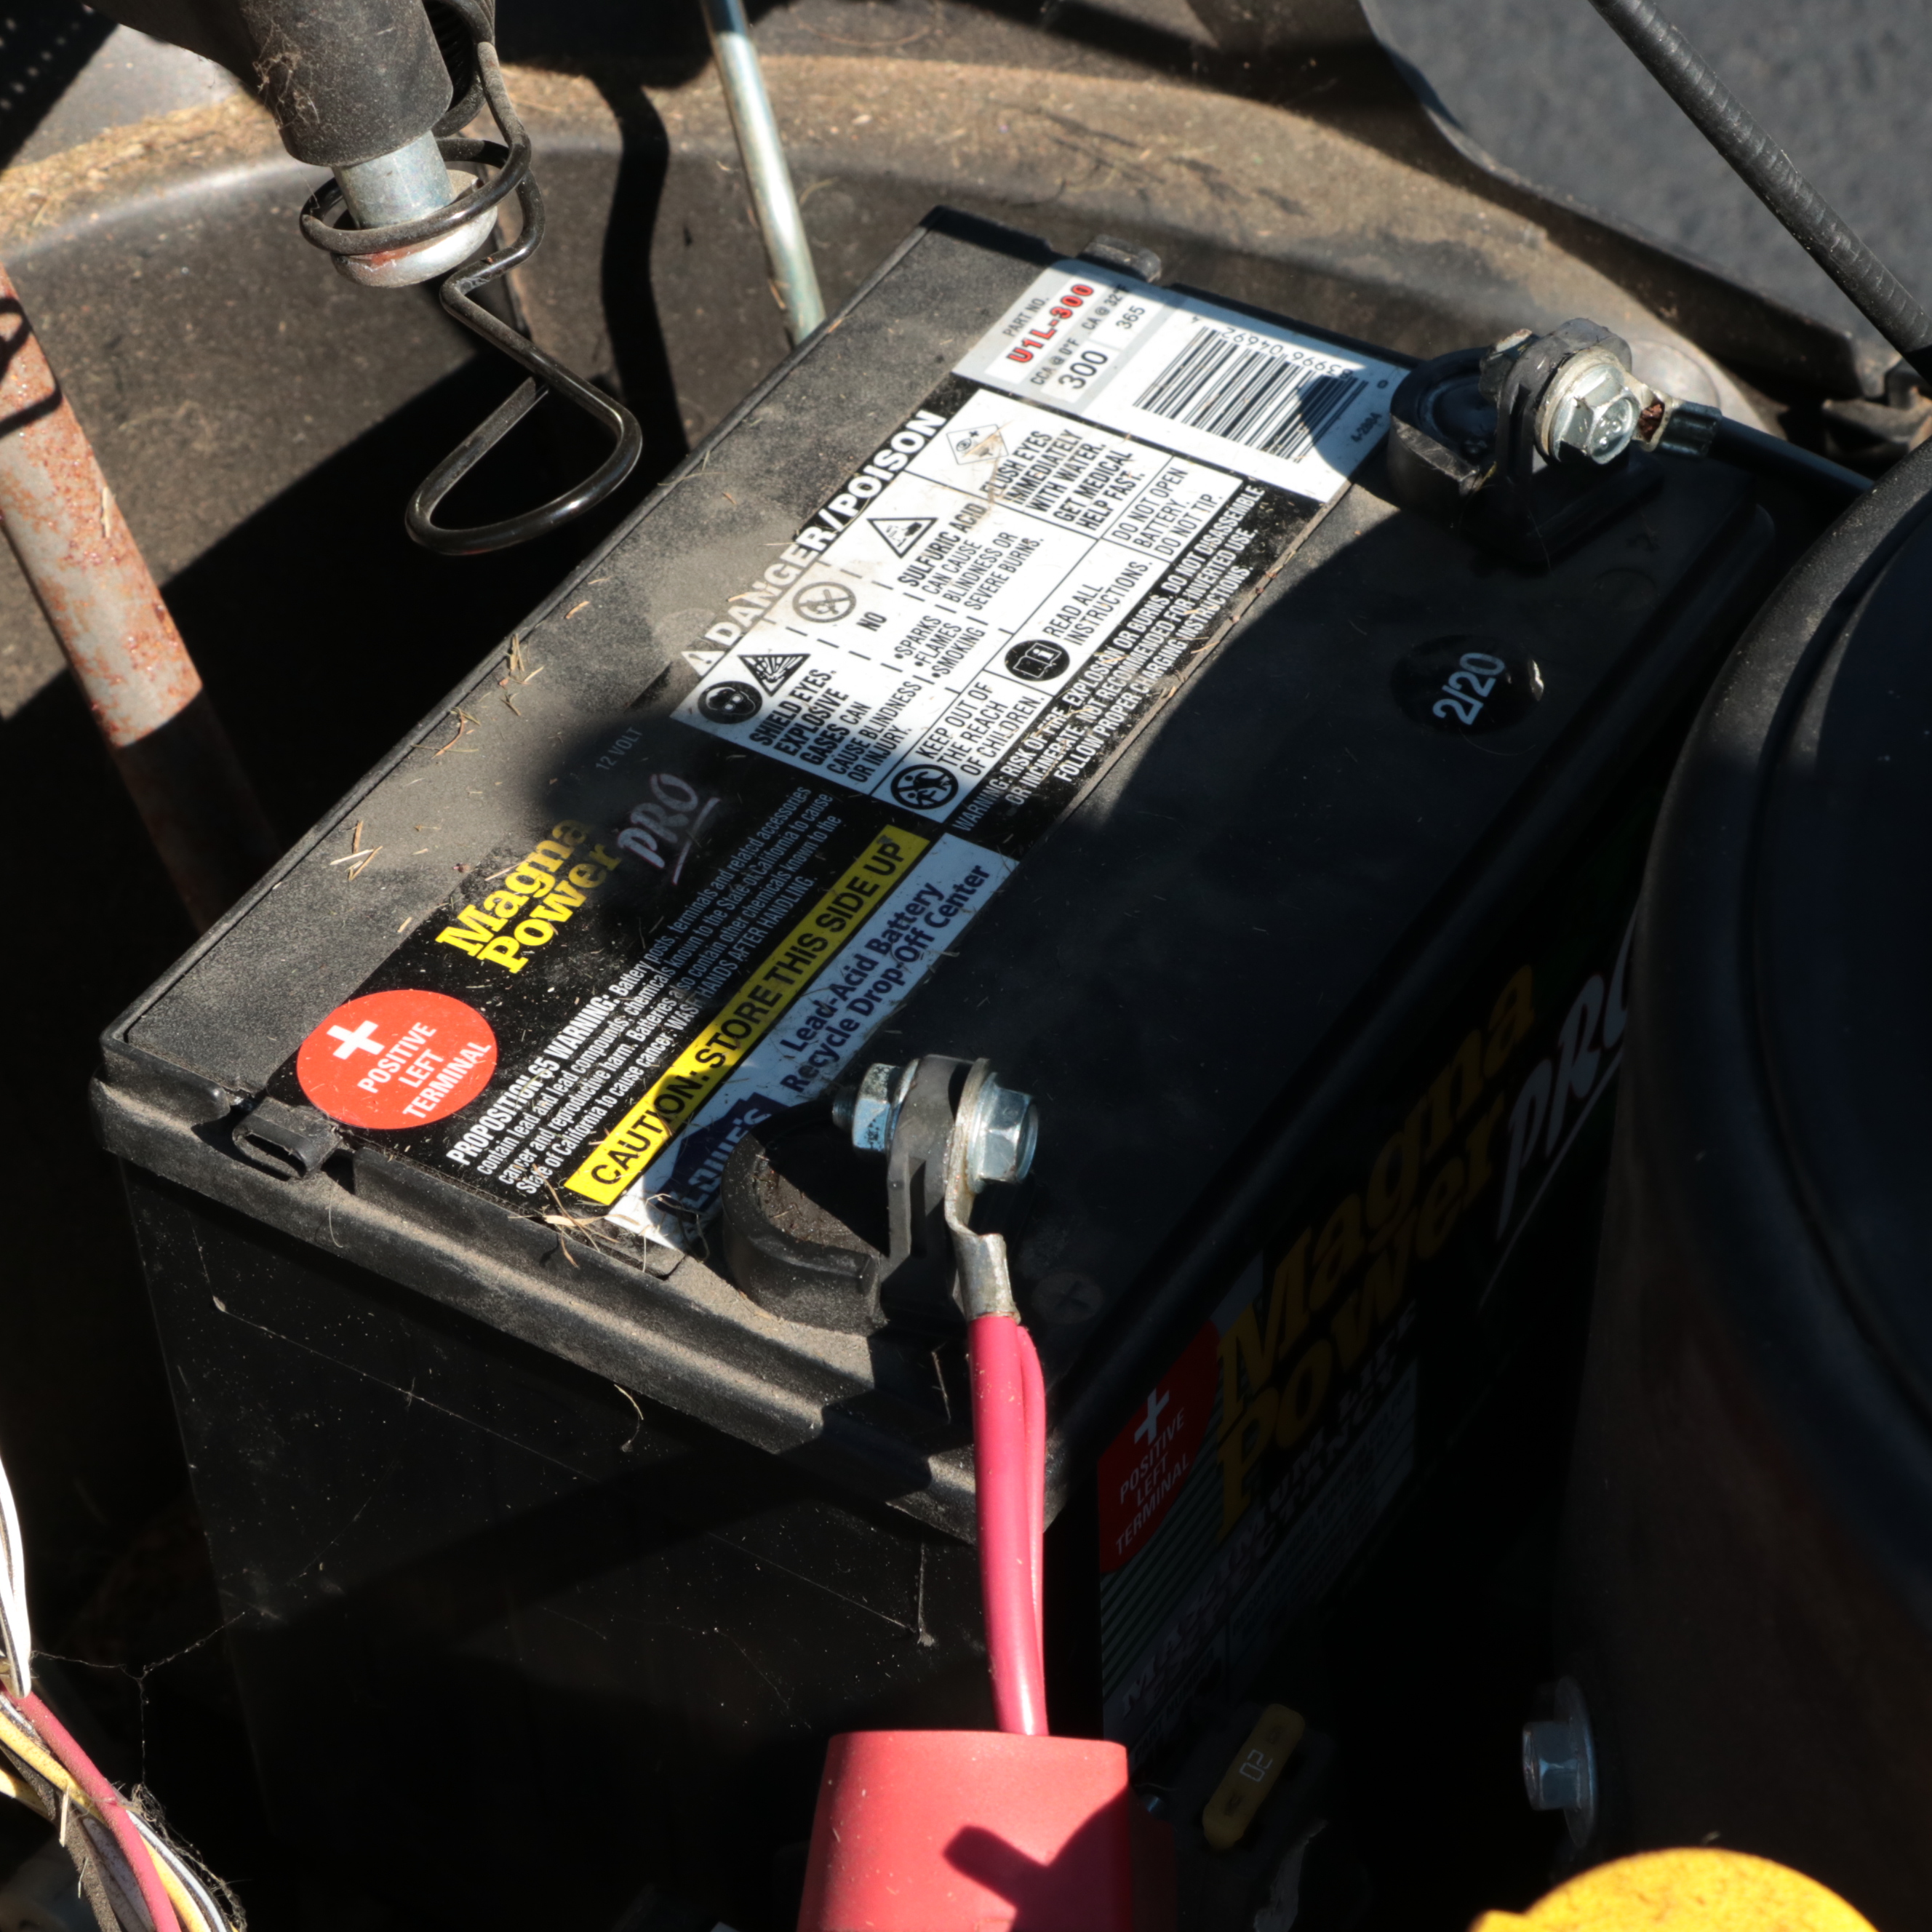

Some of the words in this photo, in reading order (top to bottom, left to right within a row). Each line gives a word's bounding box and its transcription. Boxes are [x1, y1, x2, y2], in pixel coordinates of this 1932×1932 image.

[1001, 311, 1034, 337] PART
[1023, 294, 1050, 313] NO.
[1005, 282, 1097, 364] U1L-300
[1079, 316, 1102, 330] CA
[1093, 305, 1112, 316] @
[1114, 305, 1147, 330] 365
[1218, 326, 1286, 356] 04692
[1029, 365, 1056, 386] CCA
[1047, 355, 1066, 366] @
[1055, 348, 1111, 391] 300
[978, 458, 1027, 497] FLUSH
[1011, 429, 1054, 461] EYES
[1002, 428, 1085, 505] IMMEDIATELY
[1025, 481, 1068, 513] WITH
[1053, 439, 1106, 483] WATER.
[1051, 497, 1088, 522] GET
[1071, 447, 1133, 499] MEDICAL
[1074, 498, 1117, 530] HELP
[1101, 468, 1145, 501] FAST.
[1110, 522, 1140, 540] DO
[1127, 496, 1162, 522] NOT
[1148, 467, 1188, 498] OPEN
[1132, 496, 1190, 548] BATTERY.
[1153, 536, 1183, 556] DO
[1170, 511, 1205, 538] NOT
[1190, 491, 1223, 514] TIP.
[1192, 484, 1266, 555] DISASSEMBLE
[701, 408, 948, 648] DANGER/POISON
[895, 530, 962, 588] SULFURIC
[946, 501, 989, 533] ACID
[920, 572, 952, 595] CAN
[940, 539, 983, 574] CAUSE
[941, 547, 1004, 603] BLINDNESS
[991, 531, 1018, 548] OR
[962, 571, 1010, 610] SEVERE
[997, 533, 1044, 573] BURNS.
[1159, 574, 1189, 593] DO
[1173, 551, 1209, 577] NOT
[855, 610, 889, 631] NO
[1041, 604, 1083, 637] READ
[1069, 580, 1104, 606] ALL
[1063, 556, 1153, 646] INSTRUCTIONS.
[1111, 629, 1141, 649] OR
[1004, 785, 1032, 805] OR
[1074, 696, 1109, 722] NOT
[1094, 618, 1177, 700] RECOMMENDED
[1162, 597, 1196, 622] FOR
[1181, 548, 1238, 600] INVERTED
[1061, 645, 1126, 706] EXPLOSION
[1432, 652, 1506, 726] 2/20
[747, 699, 805, 746] SHIELD
[788, 663, 837, 703] EYES.
[773, 687, 850, 757] EXPLOSIVE
[824, 736, 871, 775] CAUSE
[857, 680, 923, 740] BLINDNESS
[915, 726, 957, 759] KEEP
[942, 699, 981, 728] OUT
[965, 682, 996, 701] OF
[1053, 733, 1106, 782] FOLLOW
[1090, 690, 1143, 737] PROPER
[1128, 637, 1189, 694] CHARGING
[593, 755, 618, 771] 12
[606, 726, 644, 757] VOLT
[797, 722, 852, 766] GASES
[837, 700, 871, 725] CAN
[845, 763, 876, 783] OR
[861, 722, 912, 766] INJURY.
[936, 741, 973, 768] THE
[959, 700, 1008, 743] REACH
[959, 756, 989, 776] OF
[975, 692, 1045, 759] CHILDREN.
[1022, 731, 1052, 751] OF
[999, 747, 1037, 778] RISK
[615, 769, 704, 871] PRO
[751, 784, 813, 841] accessories
[786, 818, 810, 832] to
[799, 792, 836, 823] cause
[814, 813, 844, 833] the
[951, 774, 1013, 832] WARNING:
[722, 836, 766, 872] related
[747, 829, 801, 877] California
[778, 839, 821, 873] known
[805, 829, 829, 843] to
[436, 817, 594, 959] Magna
[705, 869, 736, 890] and
[714, 882, 752, 911] State
[735, 868, 794, 919] chemicals
[737, 870, 765, 887] of
[754, 871, 819, 930] HANDLING.
[477, 841, 624, 975] Power
[665, 886, 720, 935] terminals
[692, 923, 715, 938] to
[700, 907, 730, 927] the
[714, 914, 752, 943] other
[662, 933, 706, 969] known
[682, 938, 730, 978] contain
[724, 925, 770, 962] AFTER
[779, 953, 879, 1053] Lead-Acid
[863, 880, 949, 959] Battery
[607, 957, 658, 999] Battery
[618, 963, 678, 1017] chemicals
[663, 974, 695, 999] also
[692, 957, 741, 999] HANDS
[778, 1013, 867, 1095] Recycle
[845, 927, 942, 1019] Drop-Off
[919, 863, 993, 930] Center
[542, 990, 622, 1061] WARNING:
[586, 1066, 711, 1189] CAUTION:
[691, 983, 784, 1071] STORE
[762, 930, 831, 990] THIS
[812, 875, 881, 935] SIDE
[862, 839, 913, 877] UP
[623, 994, 679, 1042] Batteries
[663, 995, 707, 1031] WASH
[356, 1021, 437, 1094] POSITIVE
[397, 1047, 447, 1088] LEFT
[524, 1054, 563, 1080] 65
[597, 1037, 639, 1072] harm.
[633, 1028, 679, 1069] cancer.
[401, 1037, 492, 1122] TERMINAL
[527, 1091, 561, 1117] and
[543, 1066, 615, 1133] reproductive
[545, 1069, 580, 1096] lead
[593, 1093, 620, 1109] to
[607, 1064, 646, 1098] cause
[444, 1073, 544, 1167] PROPOSITION
[505, 1111, 542, 1139] lead
[524, 1126, 558, 1151] and
[548, 1103, 609, 1157] California
[472, 1133, 522, 1176] contain
[495, 1146, 540, 1186] cancer
[513, 1162, 554, 1195] State
[538, 1149, 567, 1168] of
[1213, 962, 1536, 1444] Magna
[1213, 1090, 1506, 1552] Power
[1119, 1405, 1184, 1507] POSITIVE
[1137, 1449, 1168, 1509] LEFT
[1115, 1446, 1189, 1561] TERMINAL
